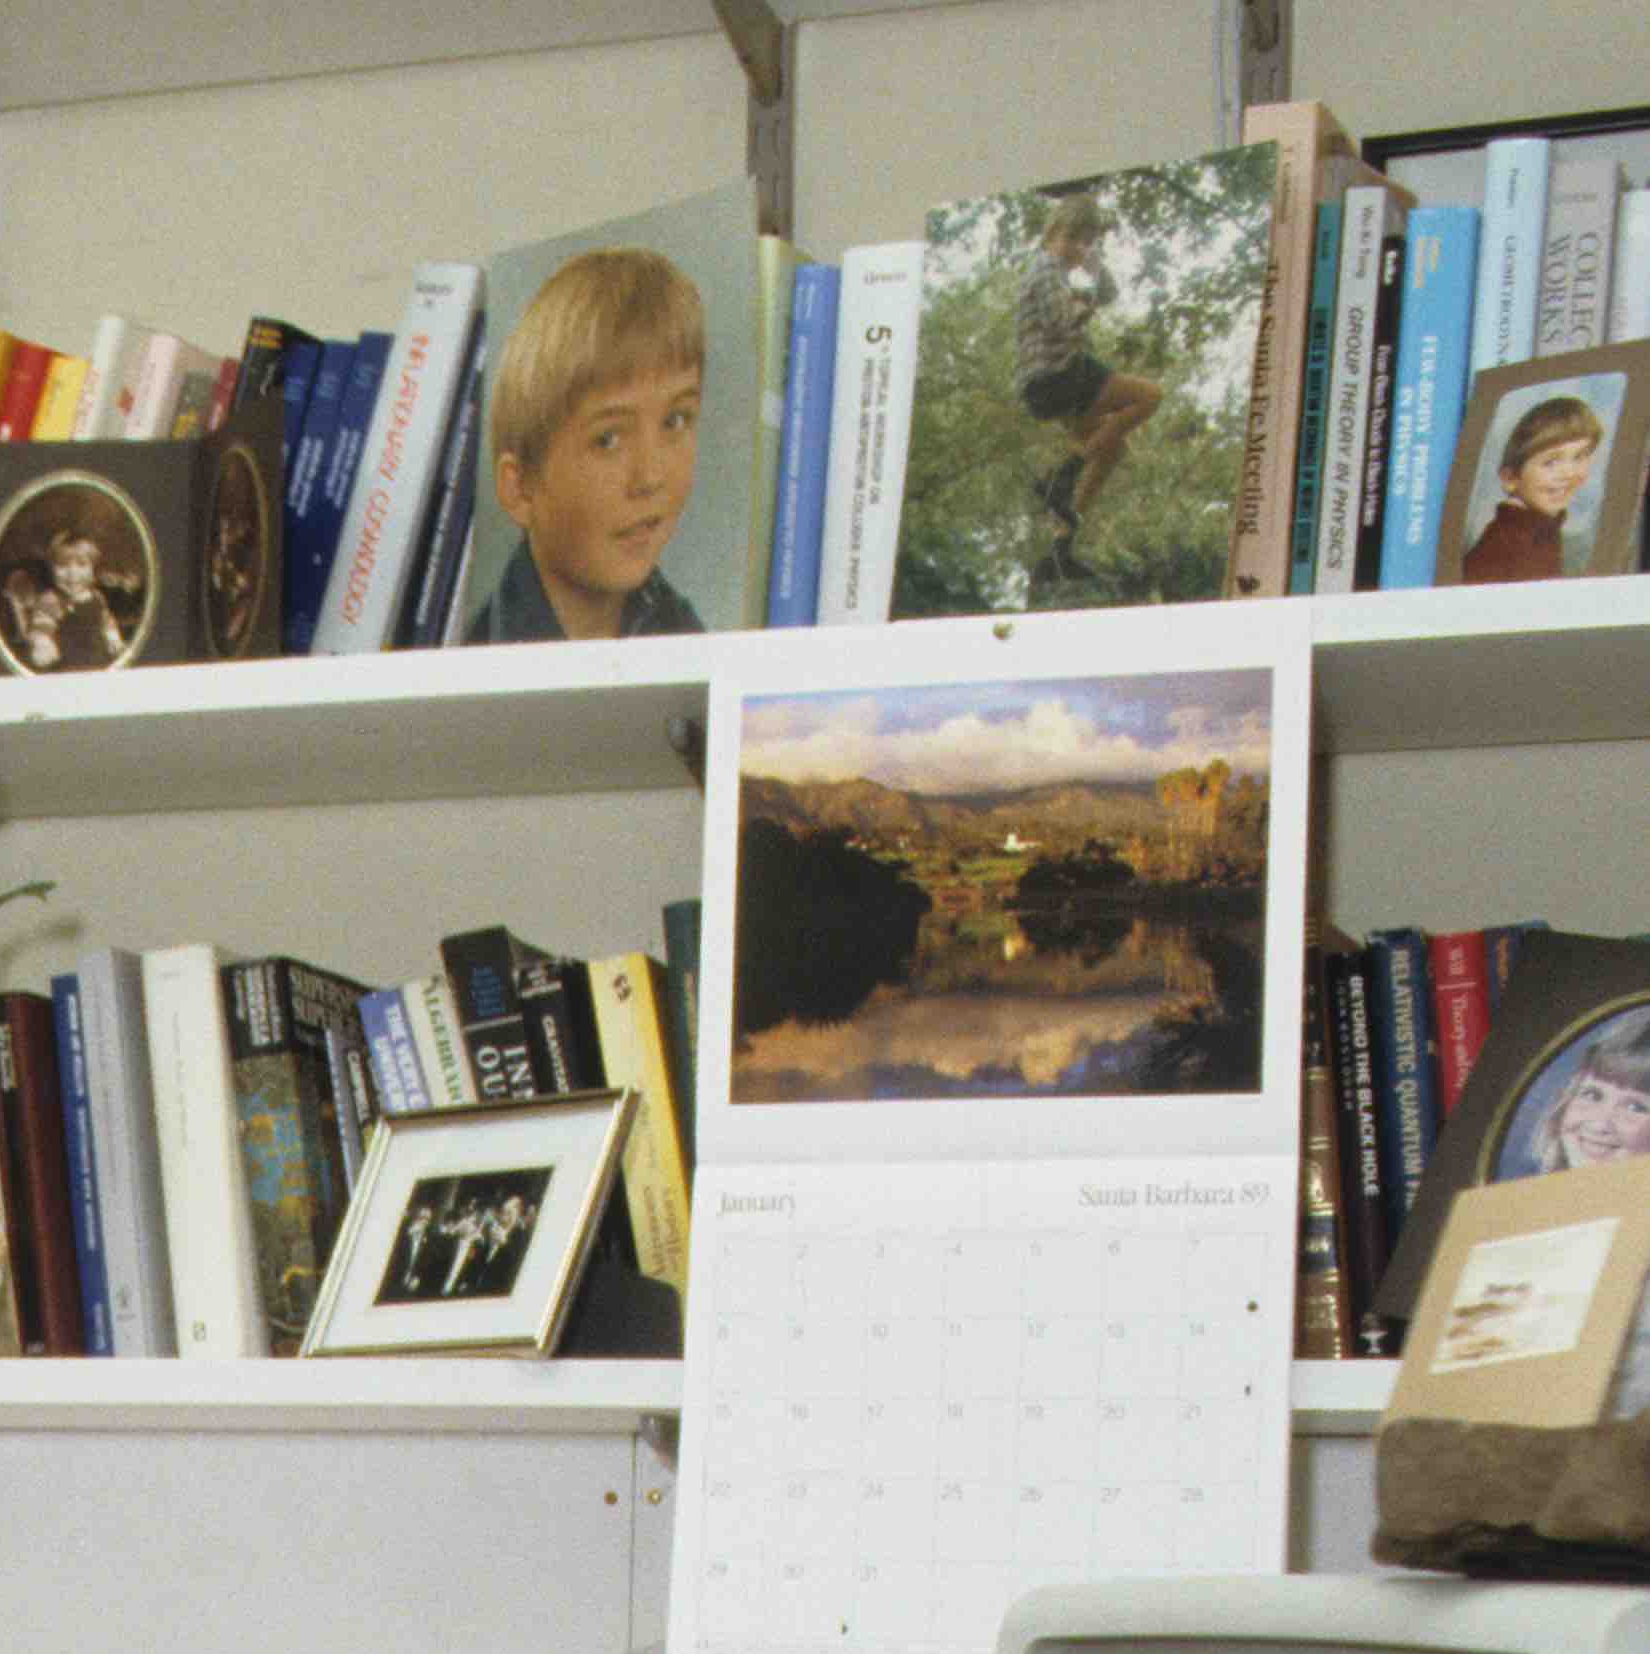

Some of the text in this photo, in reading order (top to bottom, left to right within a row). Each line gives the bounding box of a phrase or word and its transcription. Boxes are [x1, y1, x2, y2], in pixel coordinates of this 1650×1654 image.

[1236, 430, 1269, 537] Meeting
[1324, 305, 1367, 569] GROUP THEORY IN PHYSICS
[1348, 974, 1379, 1197] BEYOND THE BLACK HOLE
[1388, 947, 1421, 1174] RELATIVISTIC QUANTUM
[719, 1192, 799, 1219] January
[1077, 1180, 1272, 1209] Santa Barbara 89
